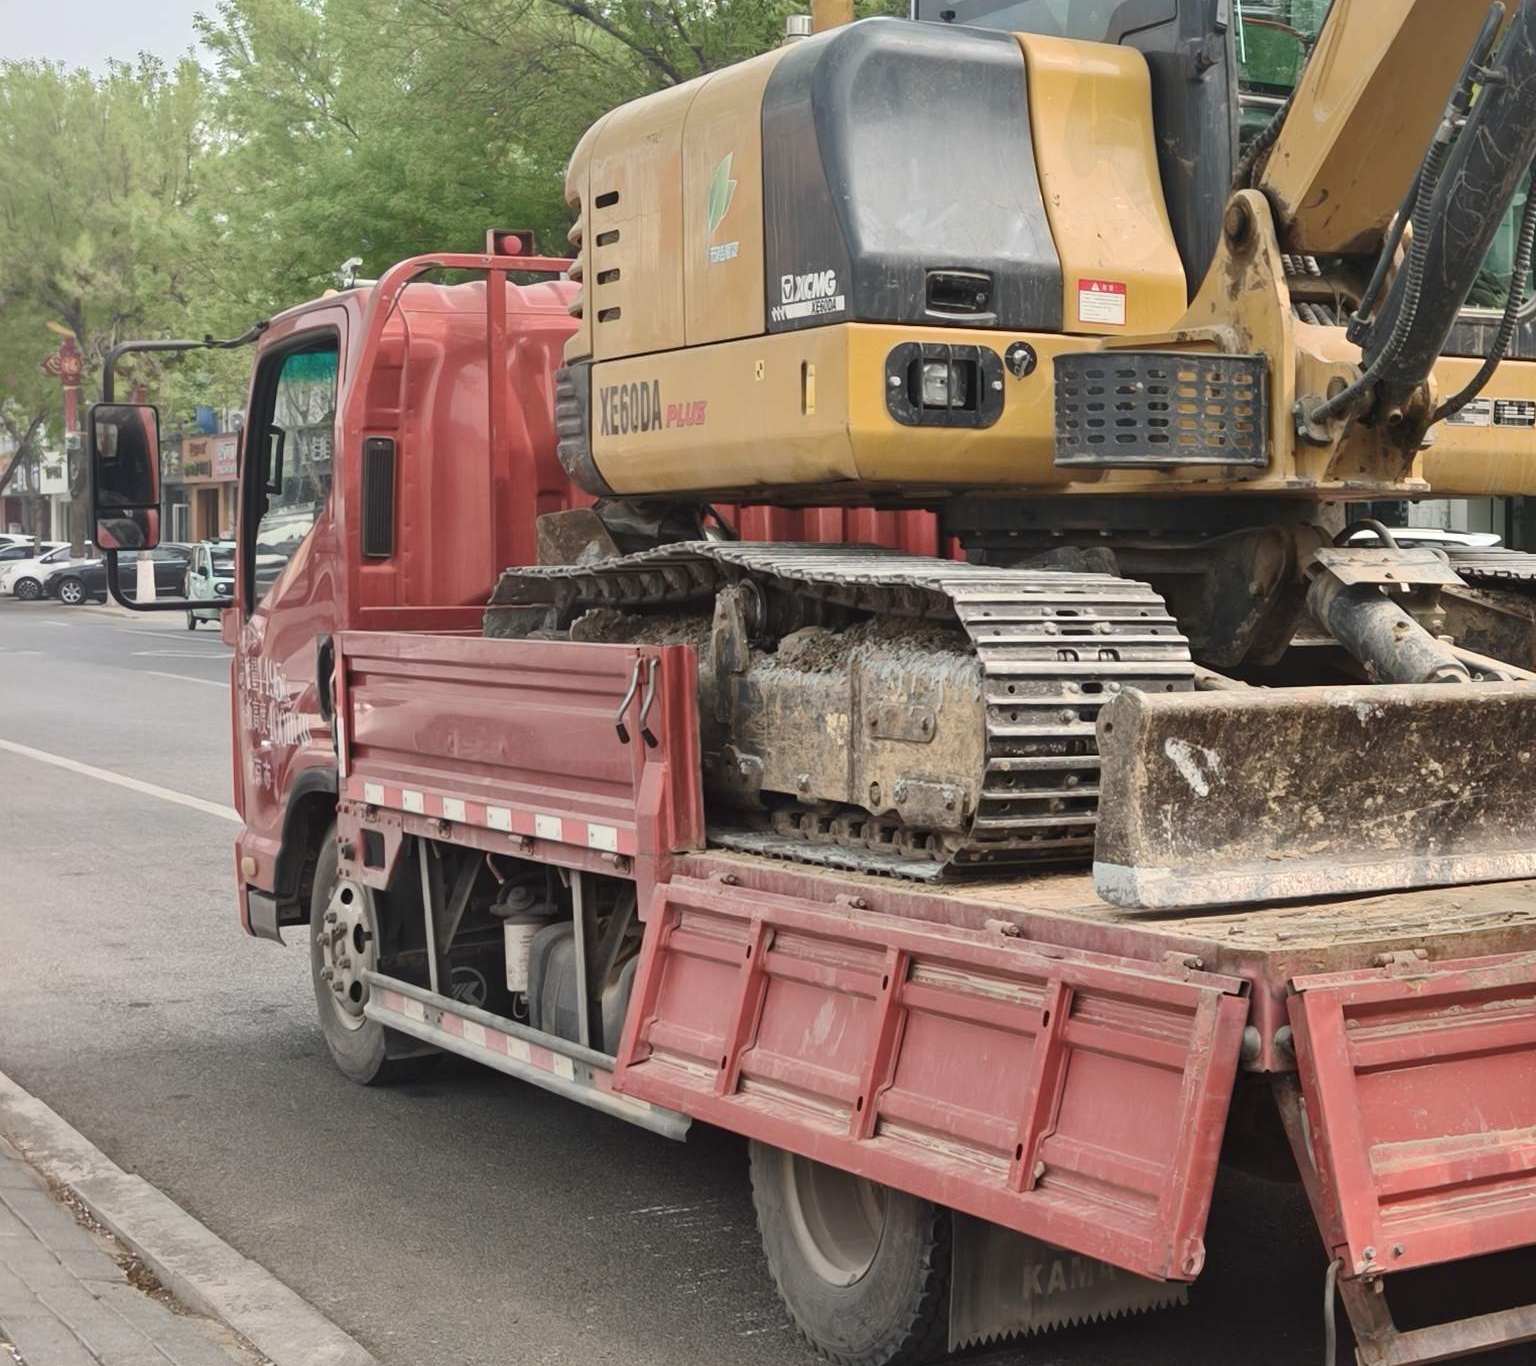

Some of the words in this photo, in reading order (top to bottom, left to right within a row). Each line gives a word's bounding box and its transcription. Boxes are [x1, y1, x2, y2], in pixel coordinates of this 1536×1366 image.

[794, 269, 836, 301] XCMG
[600, 379, 662, 436] XE60DA
[666, 401, 708, 429] PLUS
[1023, 1256, 1117, 1299] KAM
